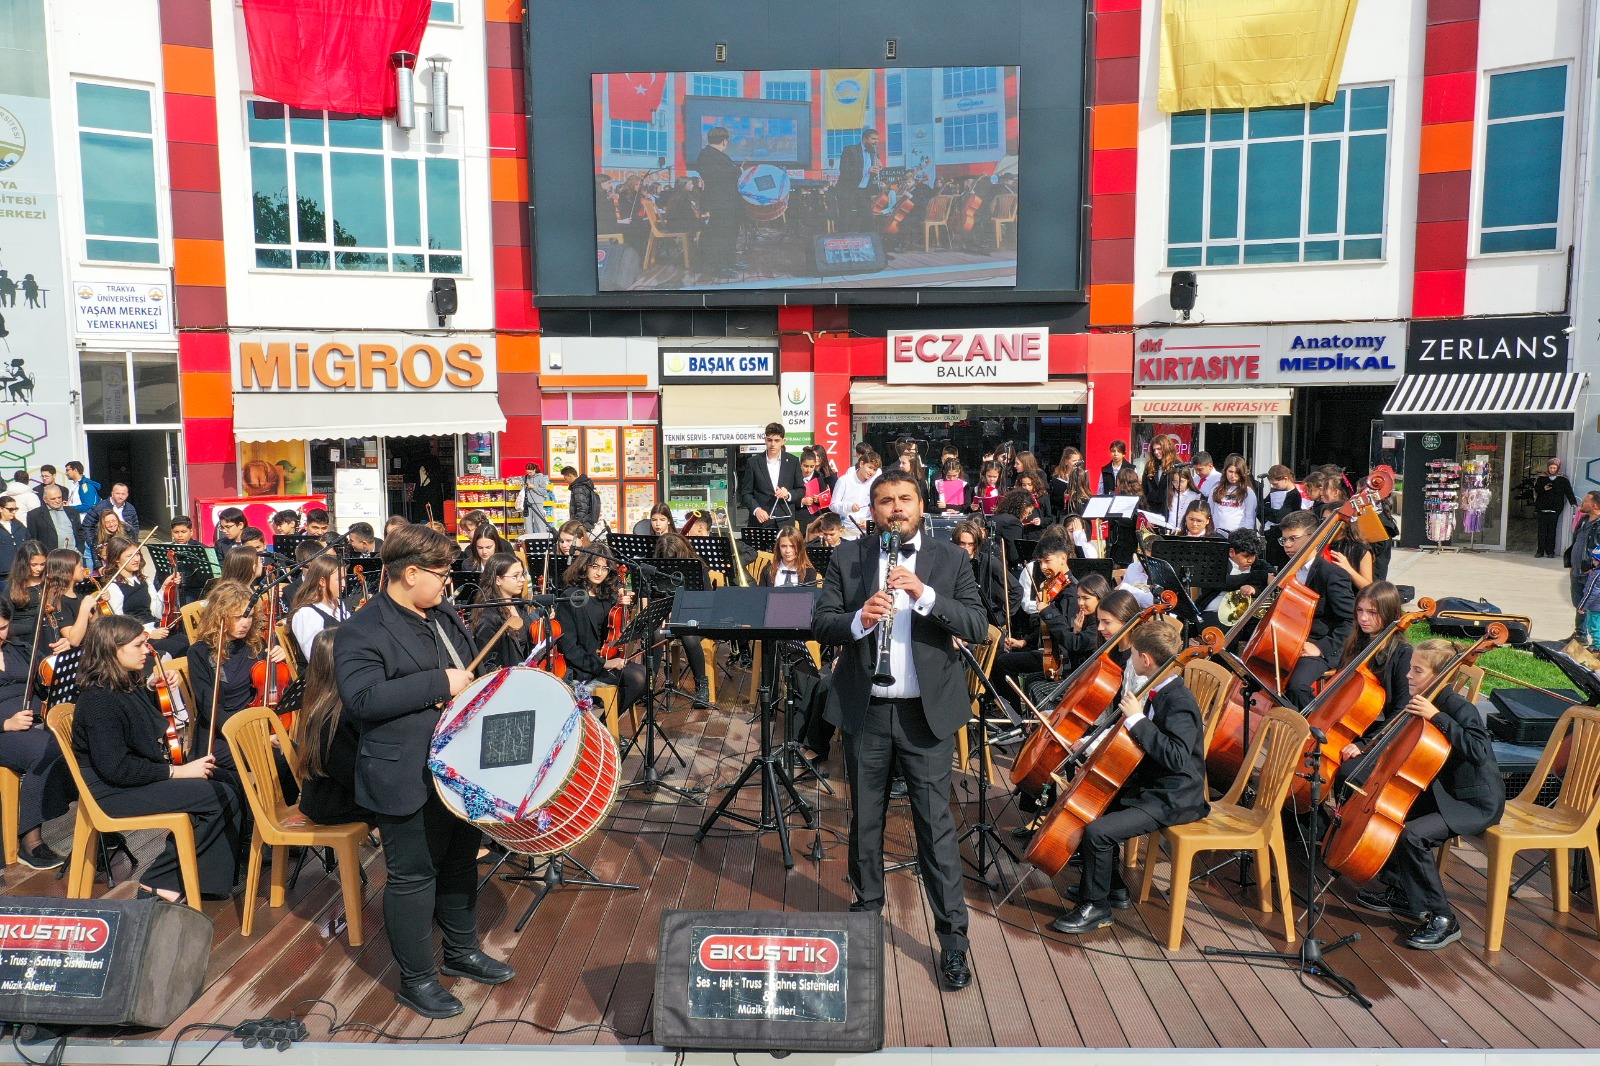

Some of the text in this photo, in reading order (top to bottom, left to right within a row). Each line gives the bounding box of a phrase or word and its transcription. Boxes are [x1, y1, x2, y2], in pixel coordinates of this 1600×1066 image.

[106, 285, 136, 293] TRAKYA
[97, 294, 146, 303] ÜNİVERSİTESİ
[80, 305, 162, 317] YAŞAM MERKEZİ
[87, 319, 158, 330] YEMEKHANESİ
[894, 332, 1041, 363] ECZANE
[1291, 335, 1387, 351] Anatomy
[1418, 335, 1557, 362] ZERLANS
[689, 357, 769, 374] BAŞAK GSM
[1280, 353, 1396, 371] MEDİKAL
[937, 365, 997, 378] BALKAN
[1143, 402, 1203, 412] UCUZLUK
[783, 410, 810, 418] BAŞAK
[665, 433, 685, 441] TEKNİK
[687, 433, 707, 441] SERVİS
[712, 433, 735, 441] FATURA
[736, 431, 756, 440] ÖDEME
[10, 955, 28, 966] Truss
[36, 956, 62, 968] Sahne
[64, 957, 104, 969] Sistemleri
[25, 968, 36, 978] &
[1, 980, 57, 992] Müzik Aletleri
[696, 976, 710, 988] Ses
[742, 977, 762, 989] Truss
[771, 977, 797, 991] Sahne
[799, 979, 840, 992] Sistemleri
[763, 991, 775, 1002] &
[738, 1003, 796, 1016] Müzik Aletleri
